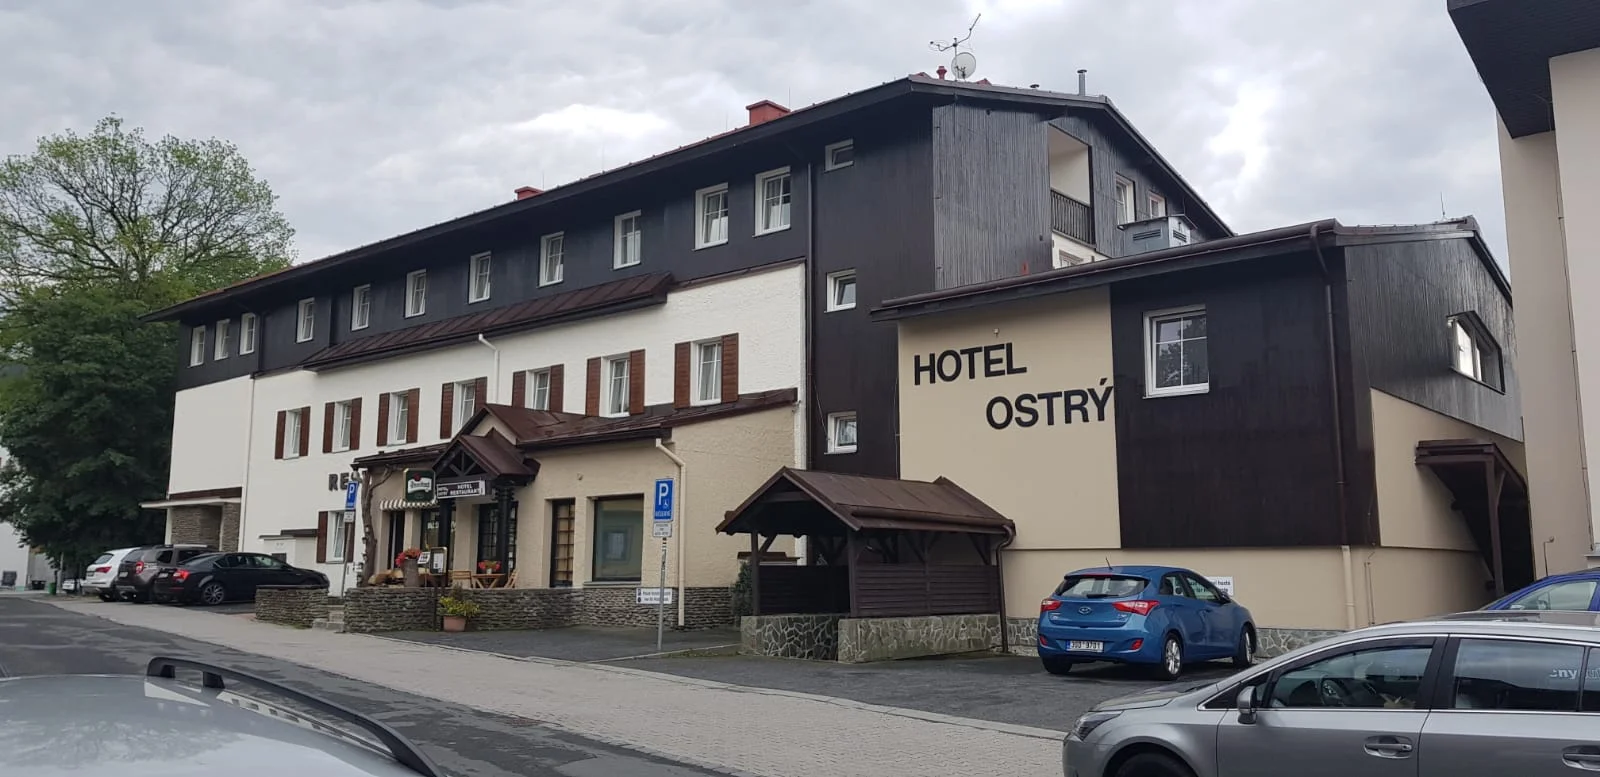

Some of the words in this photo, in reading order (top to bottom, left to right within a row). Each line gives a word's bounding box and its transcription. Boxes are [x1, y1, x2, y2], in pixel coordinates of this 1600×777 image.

[913, 342, 1027, 386] HOTEL
[985, 377, 1114, 430] OSTRÝ
[347, 483, 356, 500] P
[658, 482, 669, 506] P
